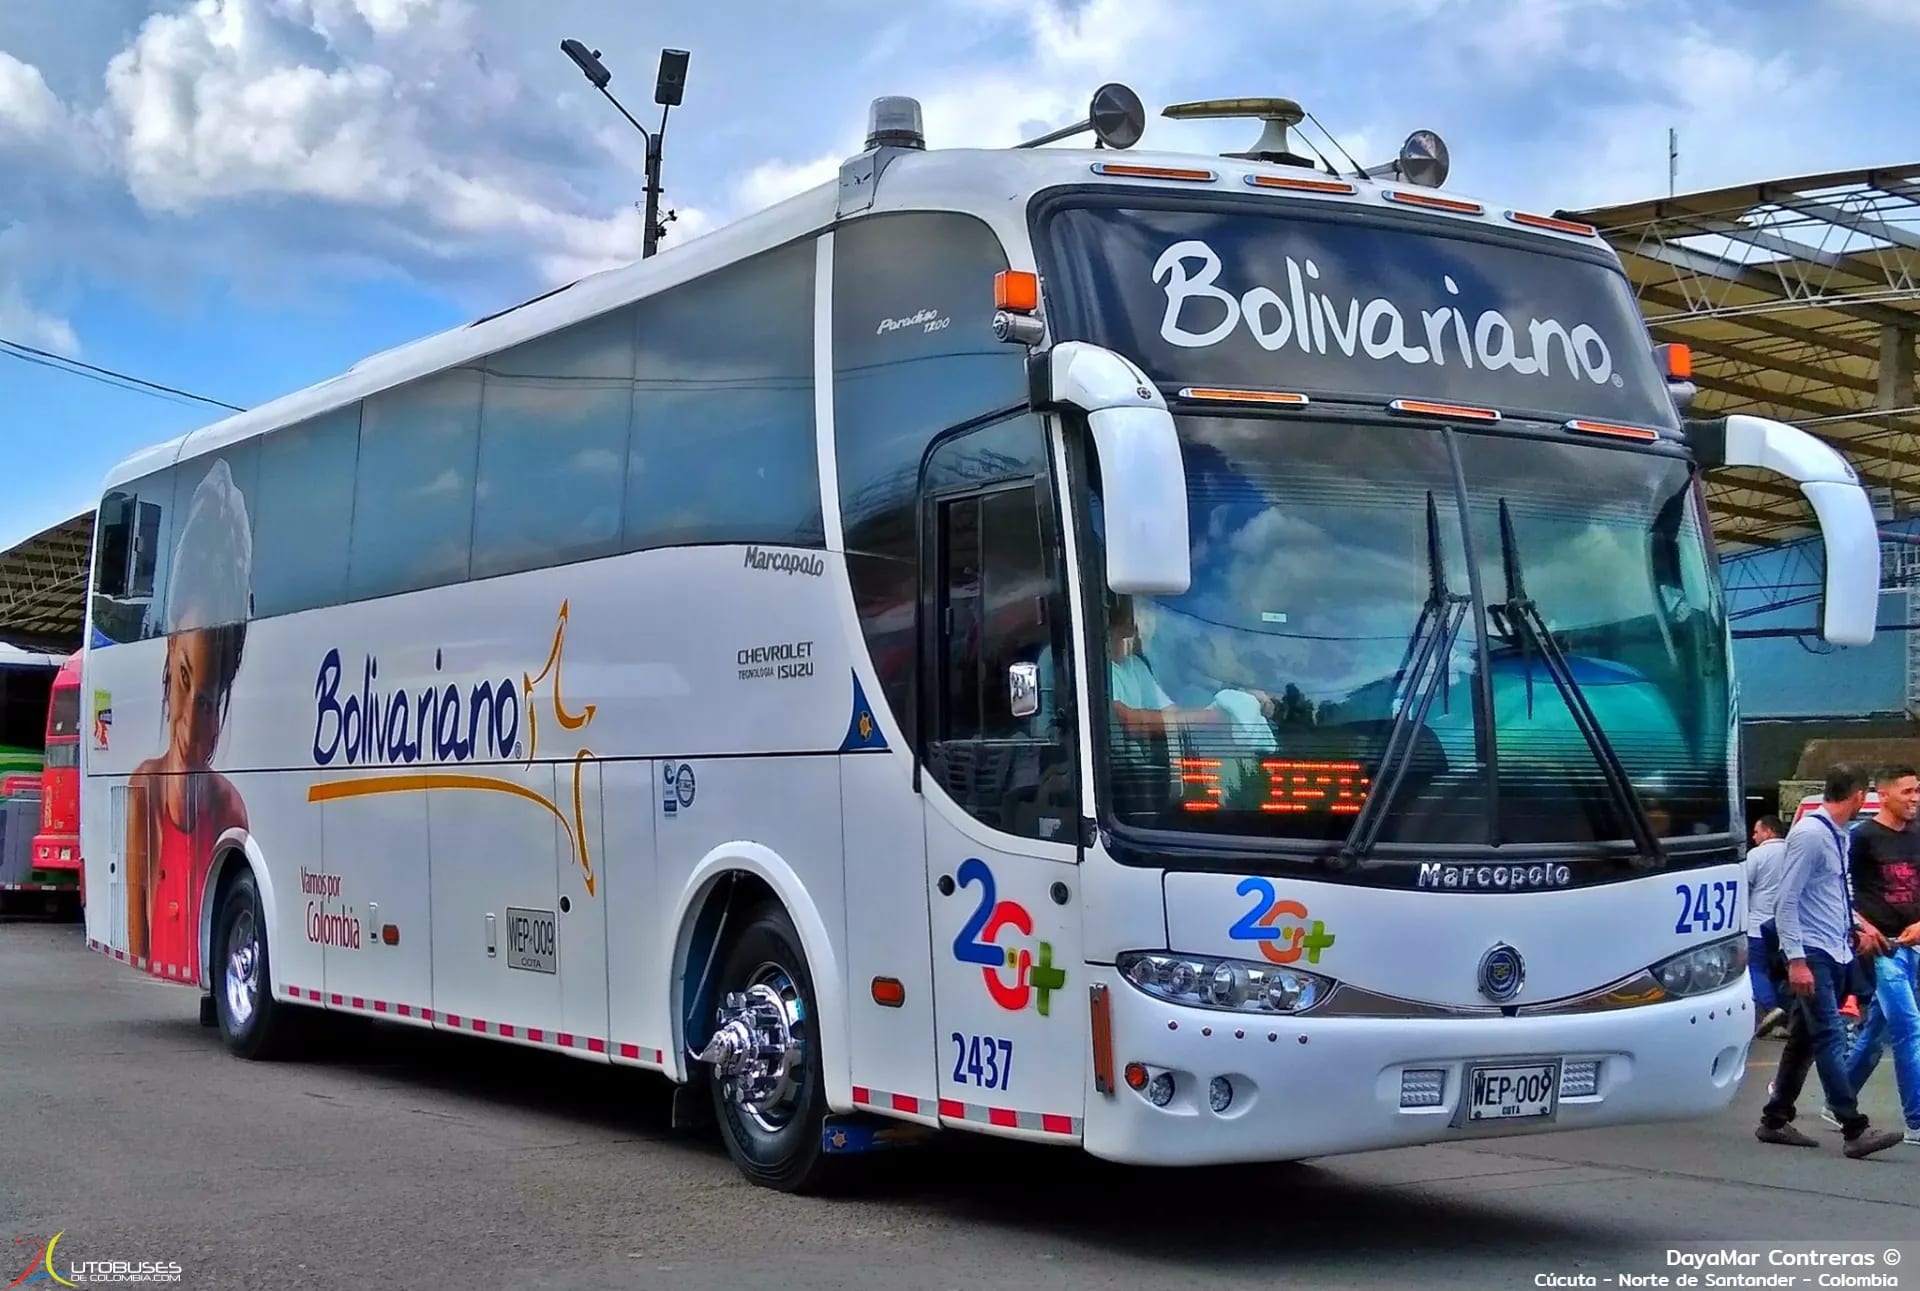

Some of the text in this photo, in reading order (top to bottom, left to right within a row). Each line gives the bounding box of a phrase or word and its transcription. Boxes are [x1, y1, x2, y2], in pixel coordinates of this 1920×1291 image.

[876, 309, 938, 335] Paradiso
[923, 317, 951, 333] 1200
[1152, 240, 1613, 385] Bolivariano
[743, 546, 825, 577] Marcopolo
[737, 641, 814, 665] CHEVROLET
[777, 662, 814, 679] ISUZU
[313, 647, 519, 766] Bolivariano
[300, 865, 341, 904] Vamos por
[1417, 862, 1571, 888] Marcopolo
[1674, 881, 1738, 934] 2437
[306, 901, 360, 950] Colombia
[508, 916, 554, 956] WEP-009
[952, 1032, 1013, 1091] 2437
[1473, 1074, 1552, 1106] WEP-009
